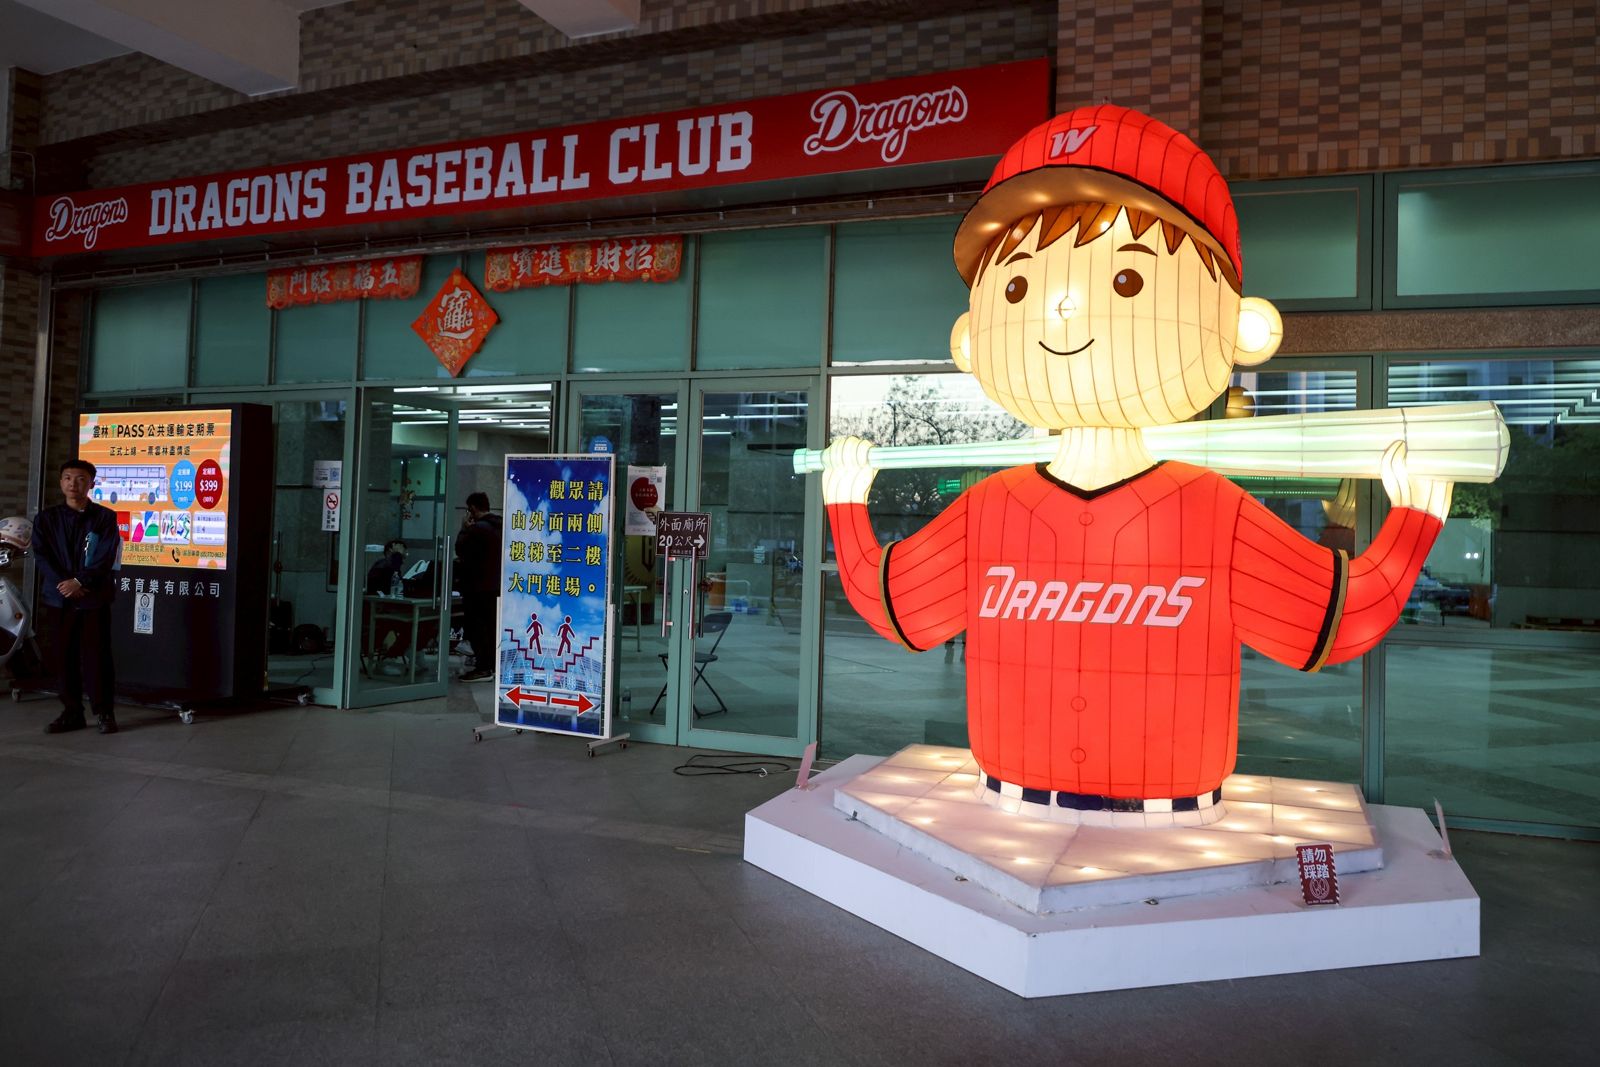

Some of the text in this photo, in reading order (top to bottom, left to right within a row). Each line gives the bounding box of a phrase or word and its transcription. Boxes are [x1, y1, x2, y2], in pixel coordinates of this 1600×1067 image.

[803, 85, 968, 163] Dragons
[1050, 125, 1099, 159] W
[149, 111, 754, 236] DRAGONS BASEBALL CLUB
[46, 196, 128, 250] Dragons
[93, 425, 109, 438] 雲林
[175, 481, 193, 492] $199
[200, 480, 218, 492] $399
[550, 480, 604, 501] 觀眾請
[511, 510, 603, 534] 由外面兩側
[509, 541, 602, 566] 樓梯至二樓
[114, 577, 220, 598] 家育樂有限公司
[979, 566, 1207, 627] DRAGONS
[1301, 848, 1327, 863] 請勿
[1303, 863, 1330, 879] 踩踏
